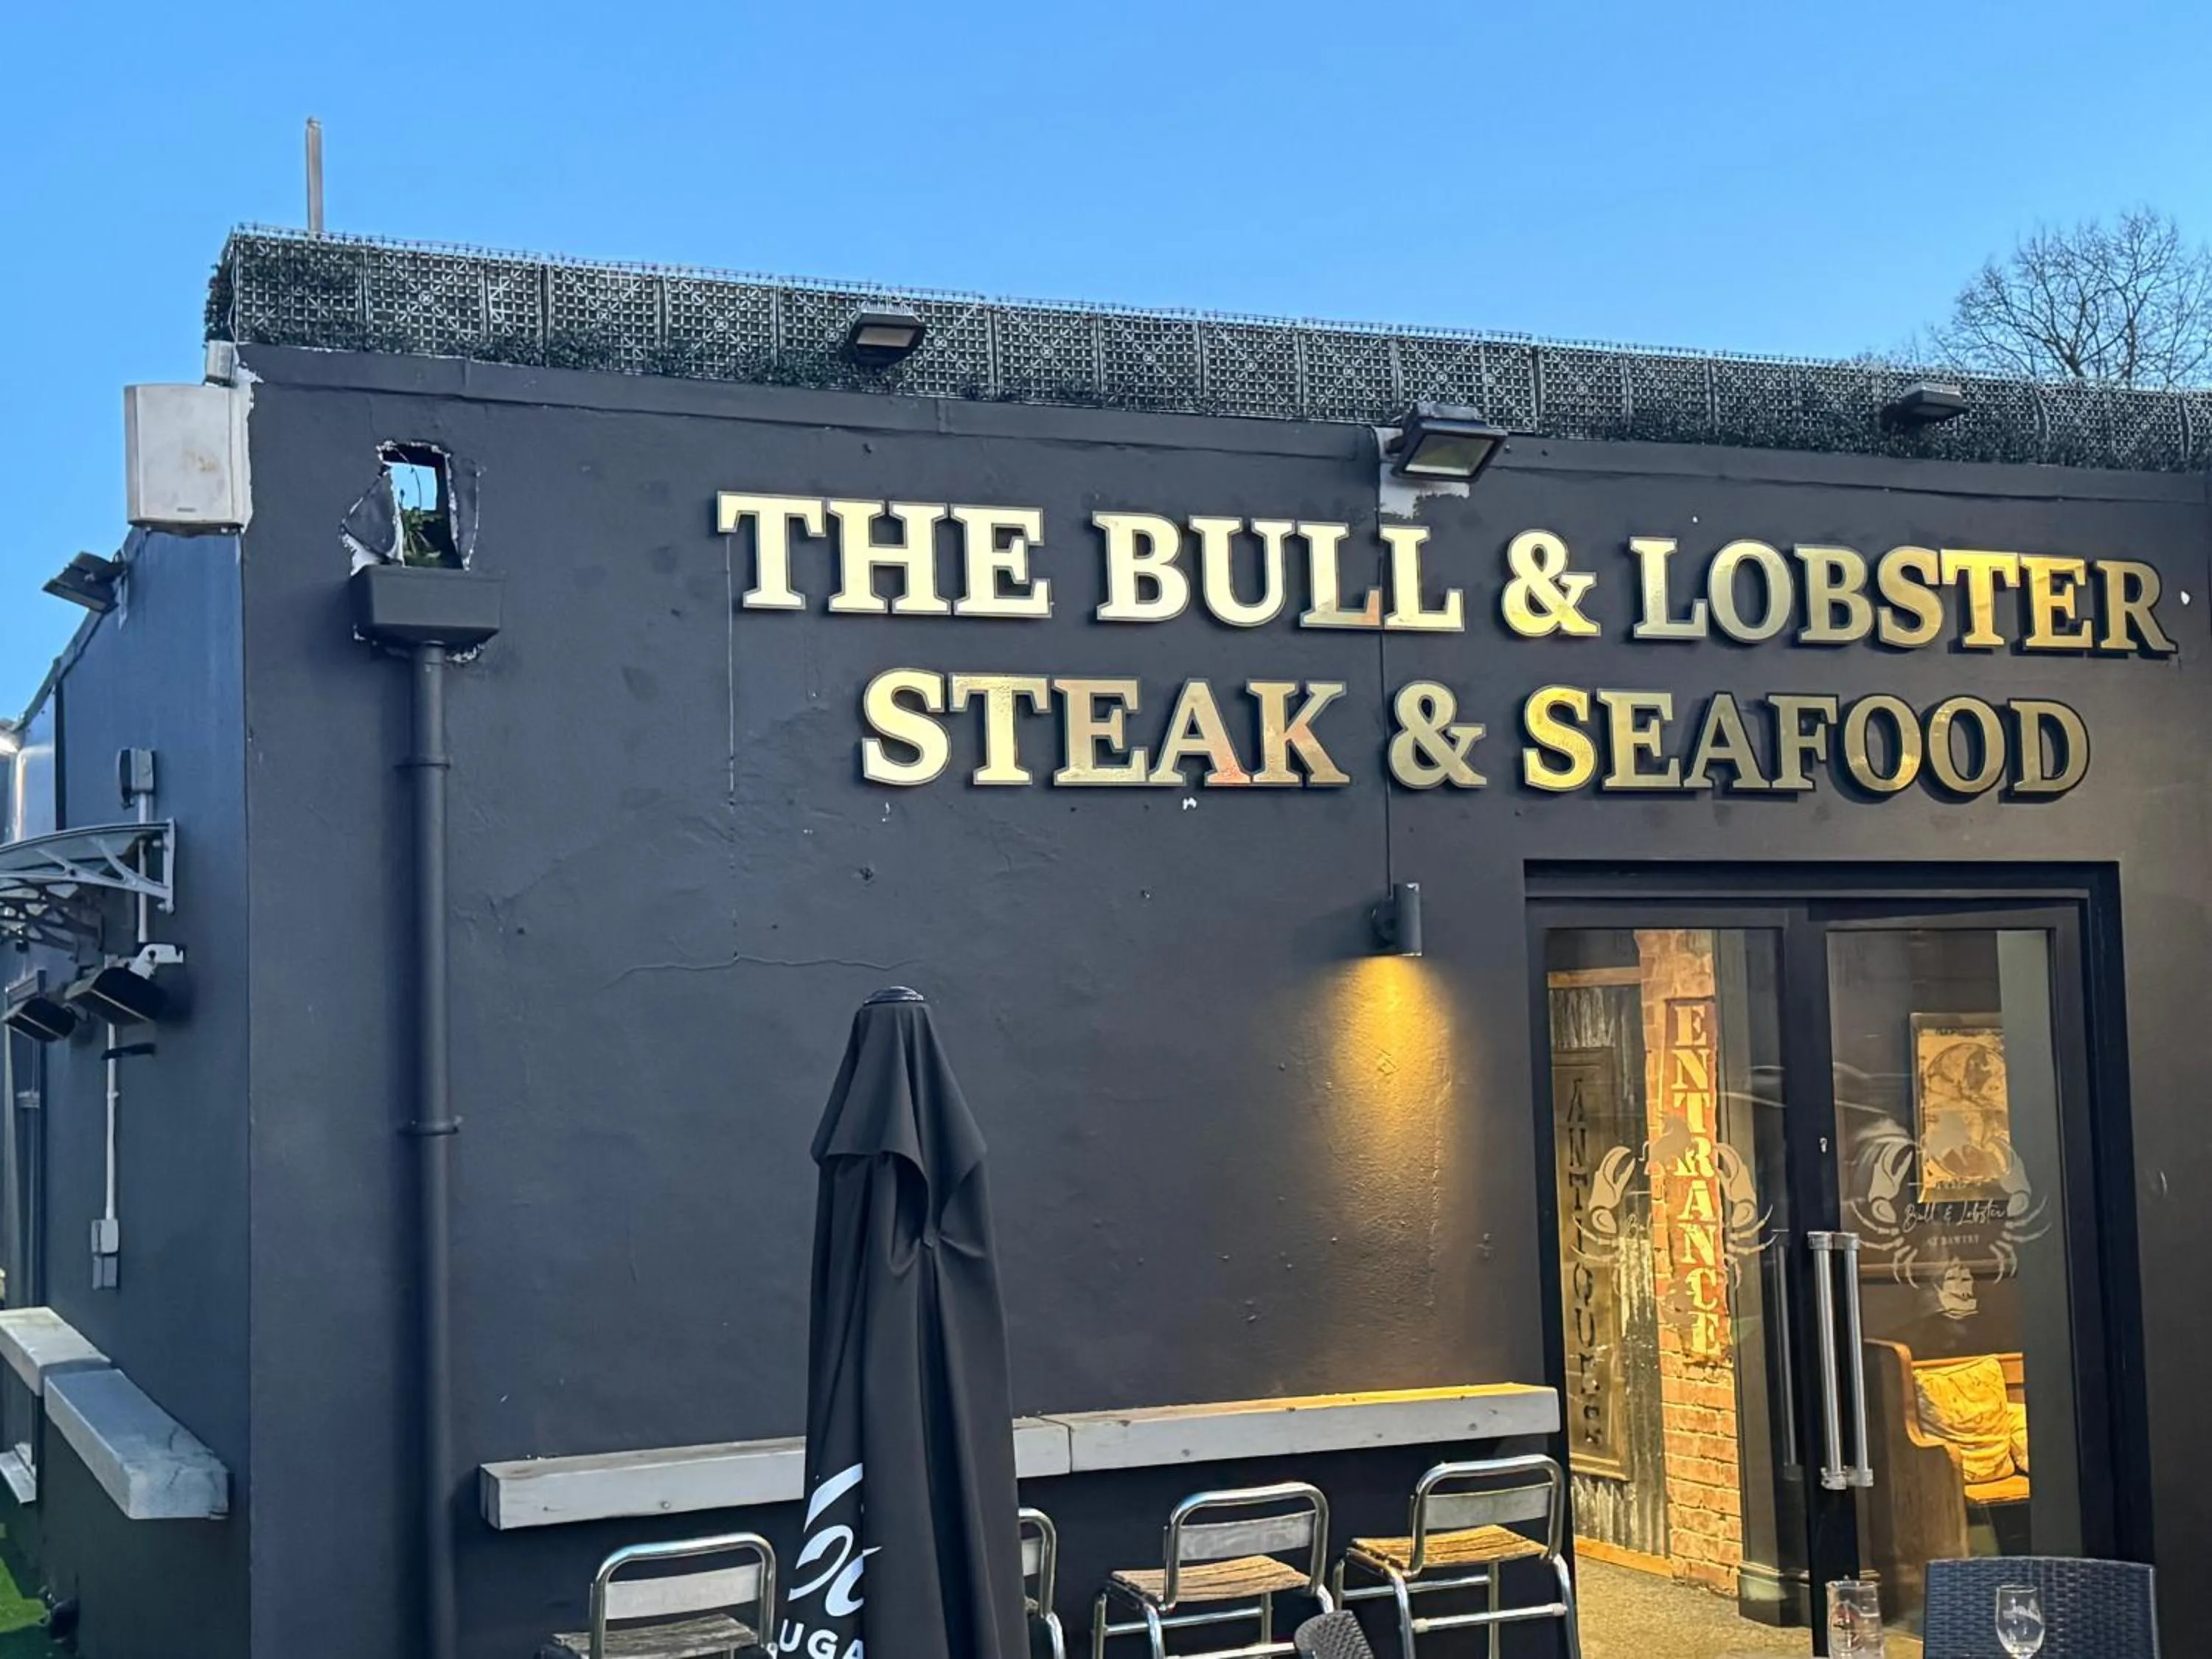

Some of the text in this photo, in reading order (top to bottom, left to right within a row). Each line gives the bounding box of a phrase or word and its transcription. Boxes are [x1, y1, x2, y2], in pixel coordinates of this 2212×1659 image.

[717, 490, 2178, 654] THE BULL & LOBSTER
[861, 667, 2090, 794] STEAK & SEAFOOD
[1670, 1004, 1722, 1357] ENTRANCE
